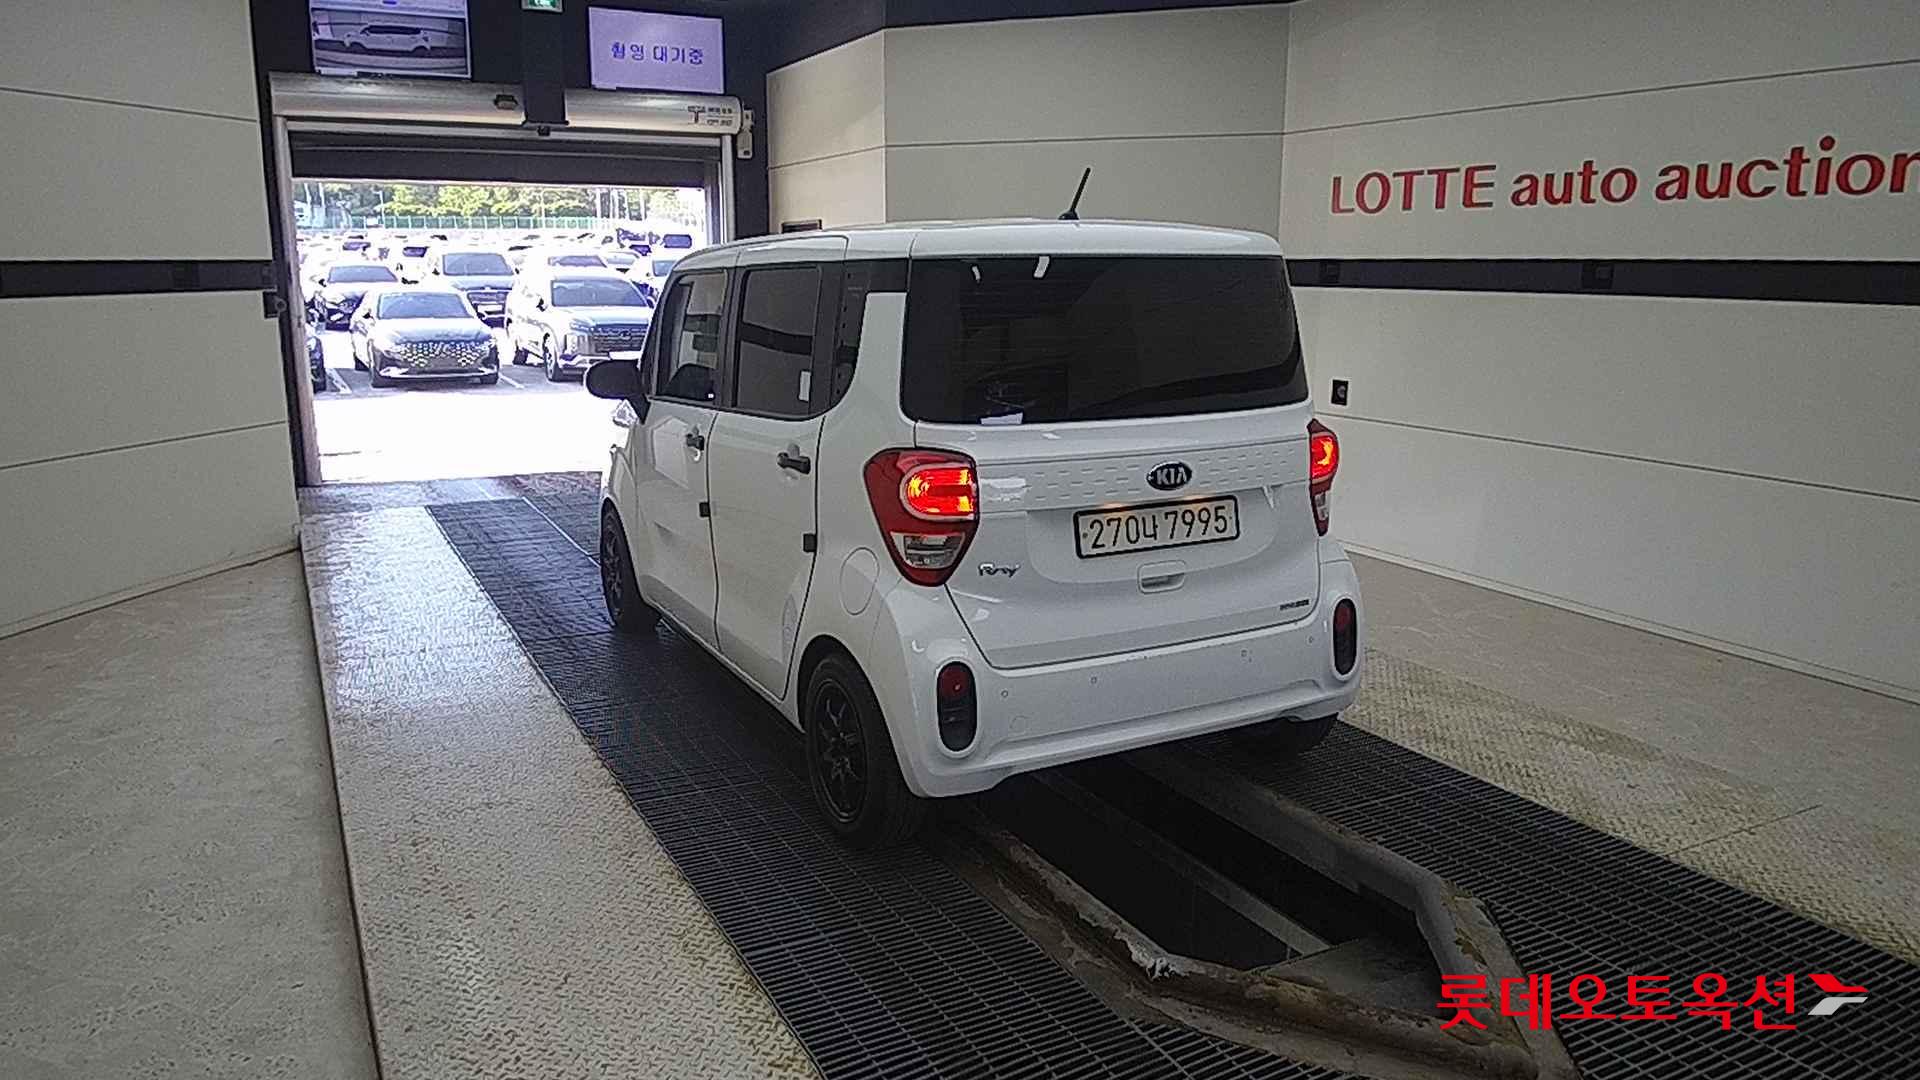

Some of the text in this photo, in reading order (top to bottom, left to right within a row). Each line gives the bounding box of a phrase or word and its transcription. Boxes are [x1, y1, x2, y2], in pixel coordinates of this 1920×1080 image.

[653, 45, 704, 65] 대기중
[1331, 164, 1497, 214] LOTTE
[1511, 160, 1638, 206] auto
[1156, 466, 1187, 485] KIA
[1164, 505, 1228, 540] 7995
